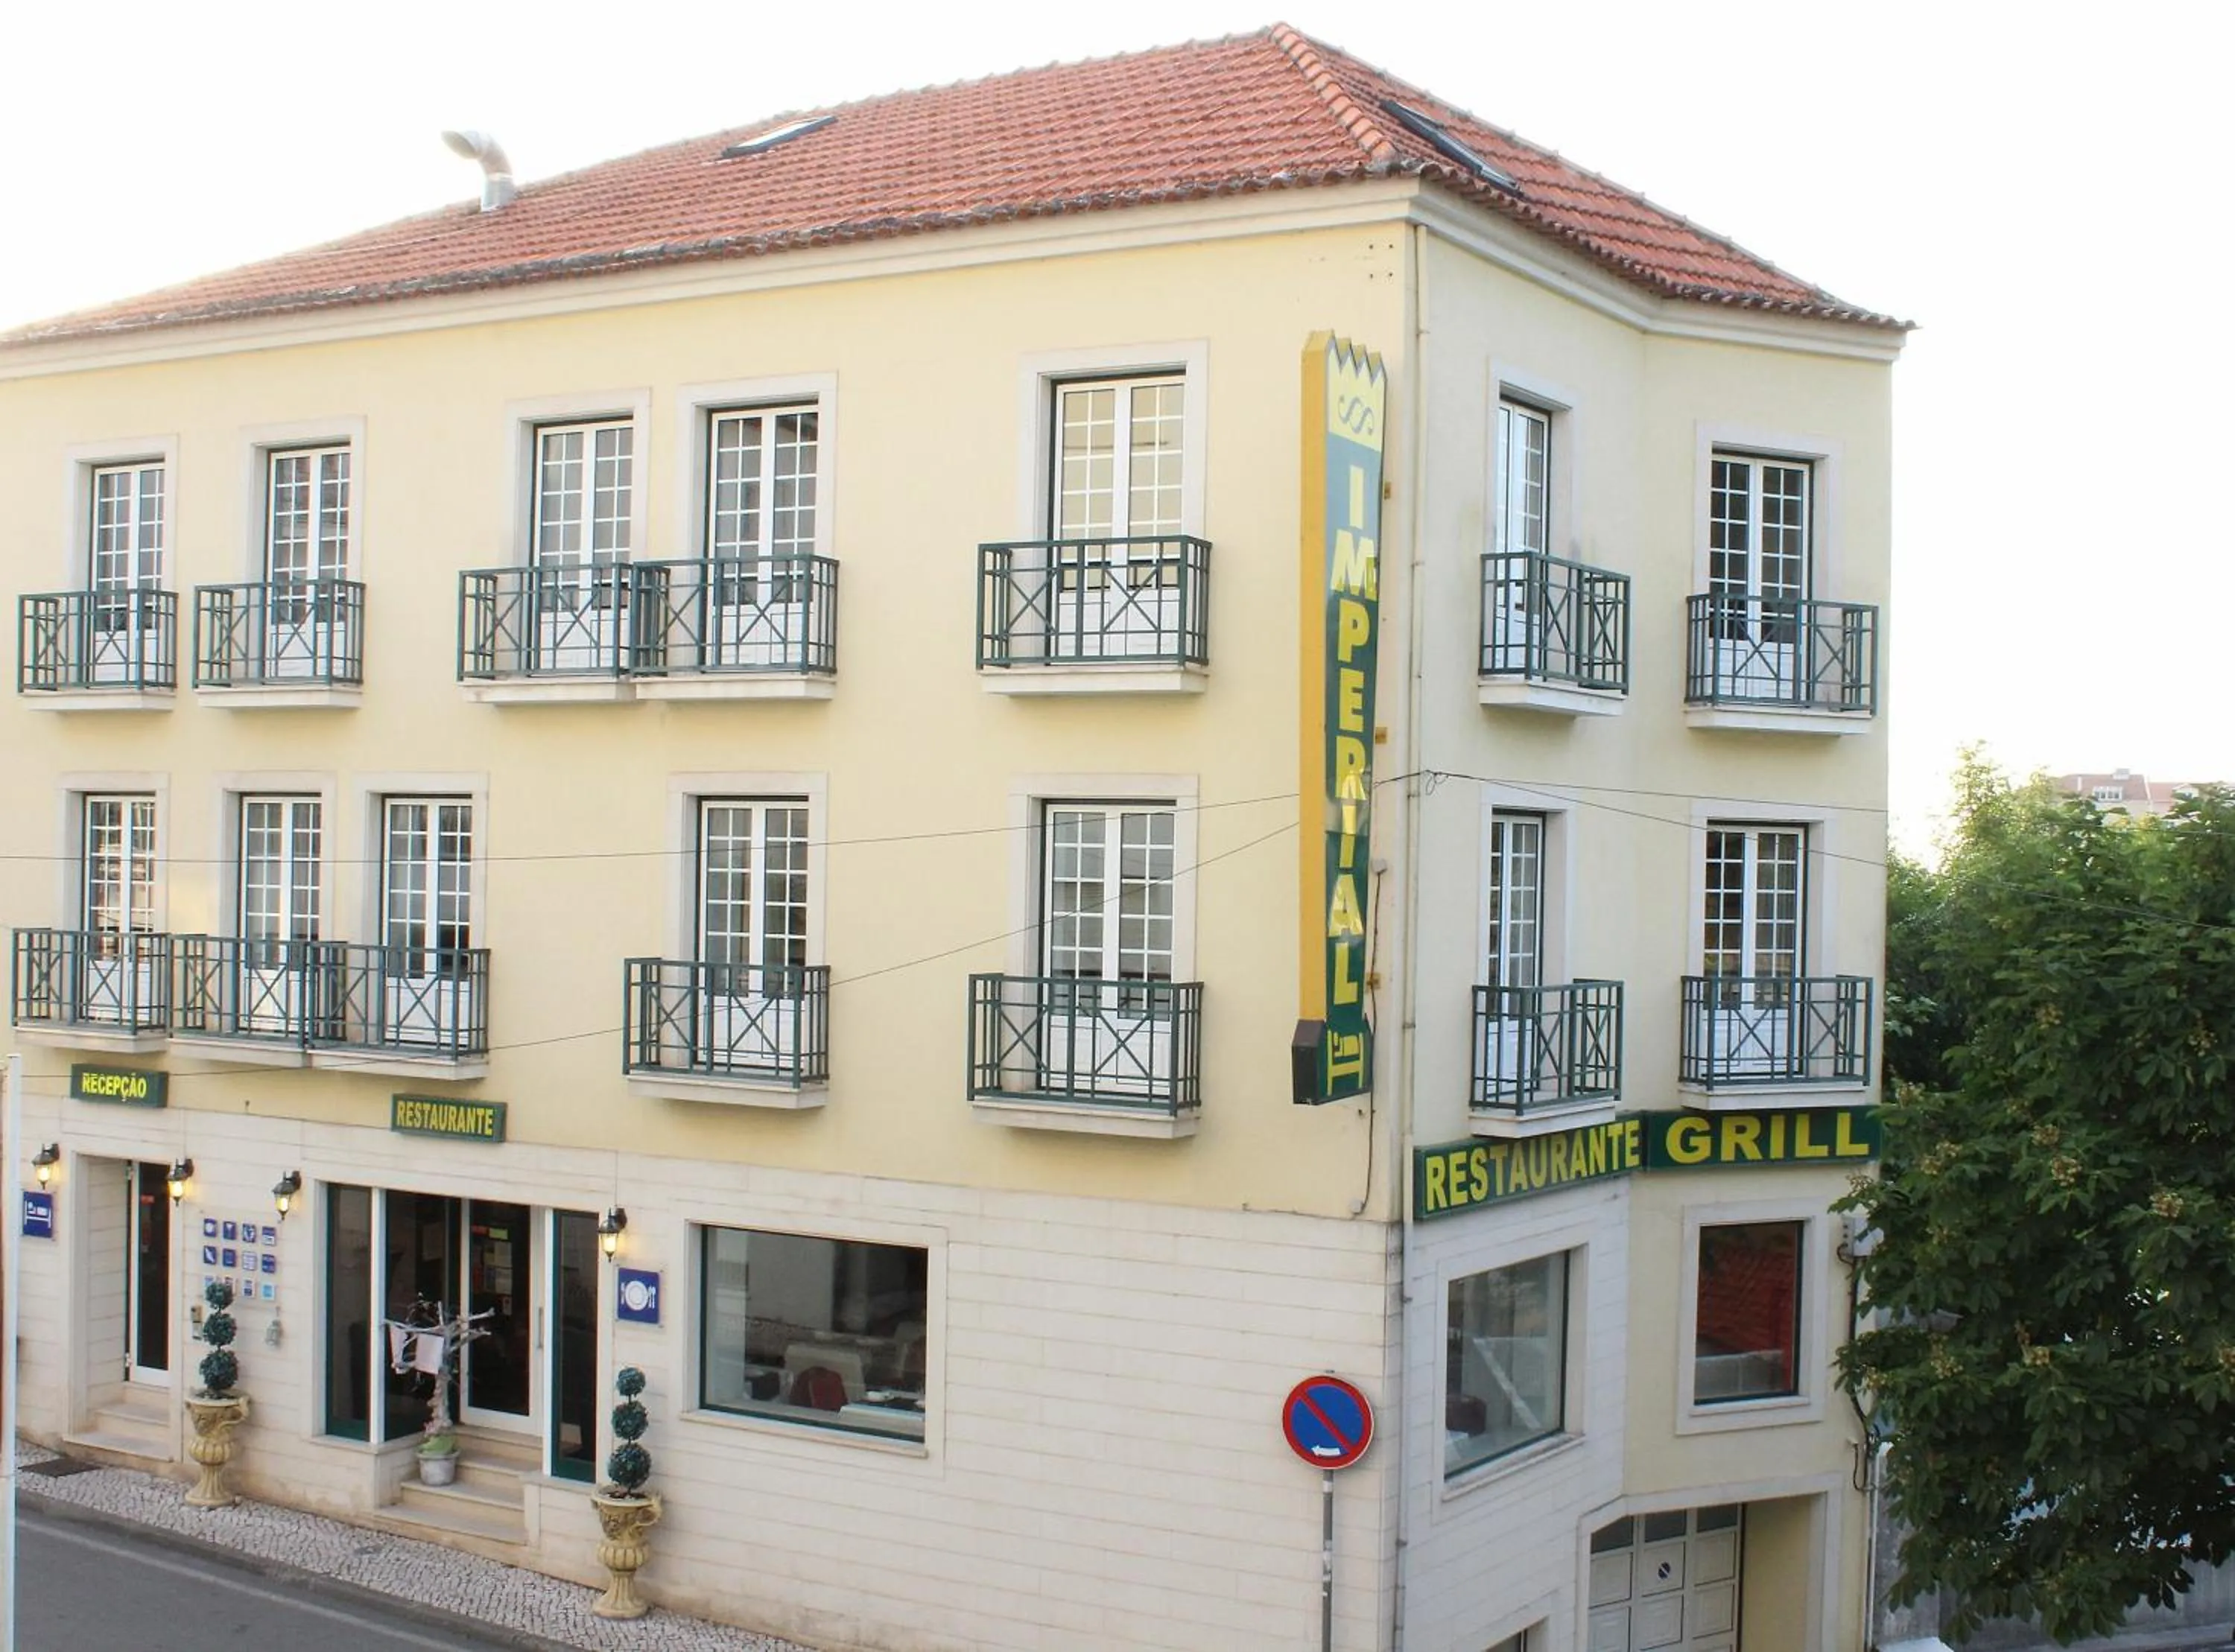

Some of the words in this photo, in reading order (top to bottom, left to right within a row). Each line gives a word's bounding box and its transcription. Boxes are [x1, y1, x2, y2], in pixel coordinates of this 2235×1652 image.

[1328, 466, 1378, 1006] IMPERIAL
[82, 1072, 147, 1102] RECEPÇÃO
[396, 1100, 494, 1137] RESTAURANTE
[1425, 1119, 1640, 1211] RESTAURANTE
[1665, 1112, 1871, 1163] GRILL
